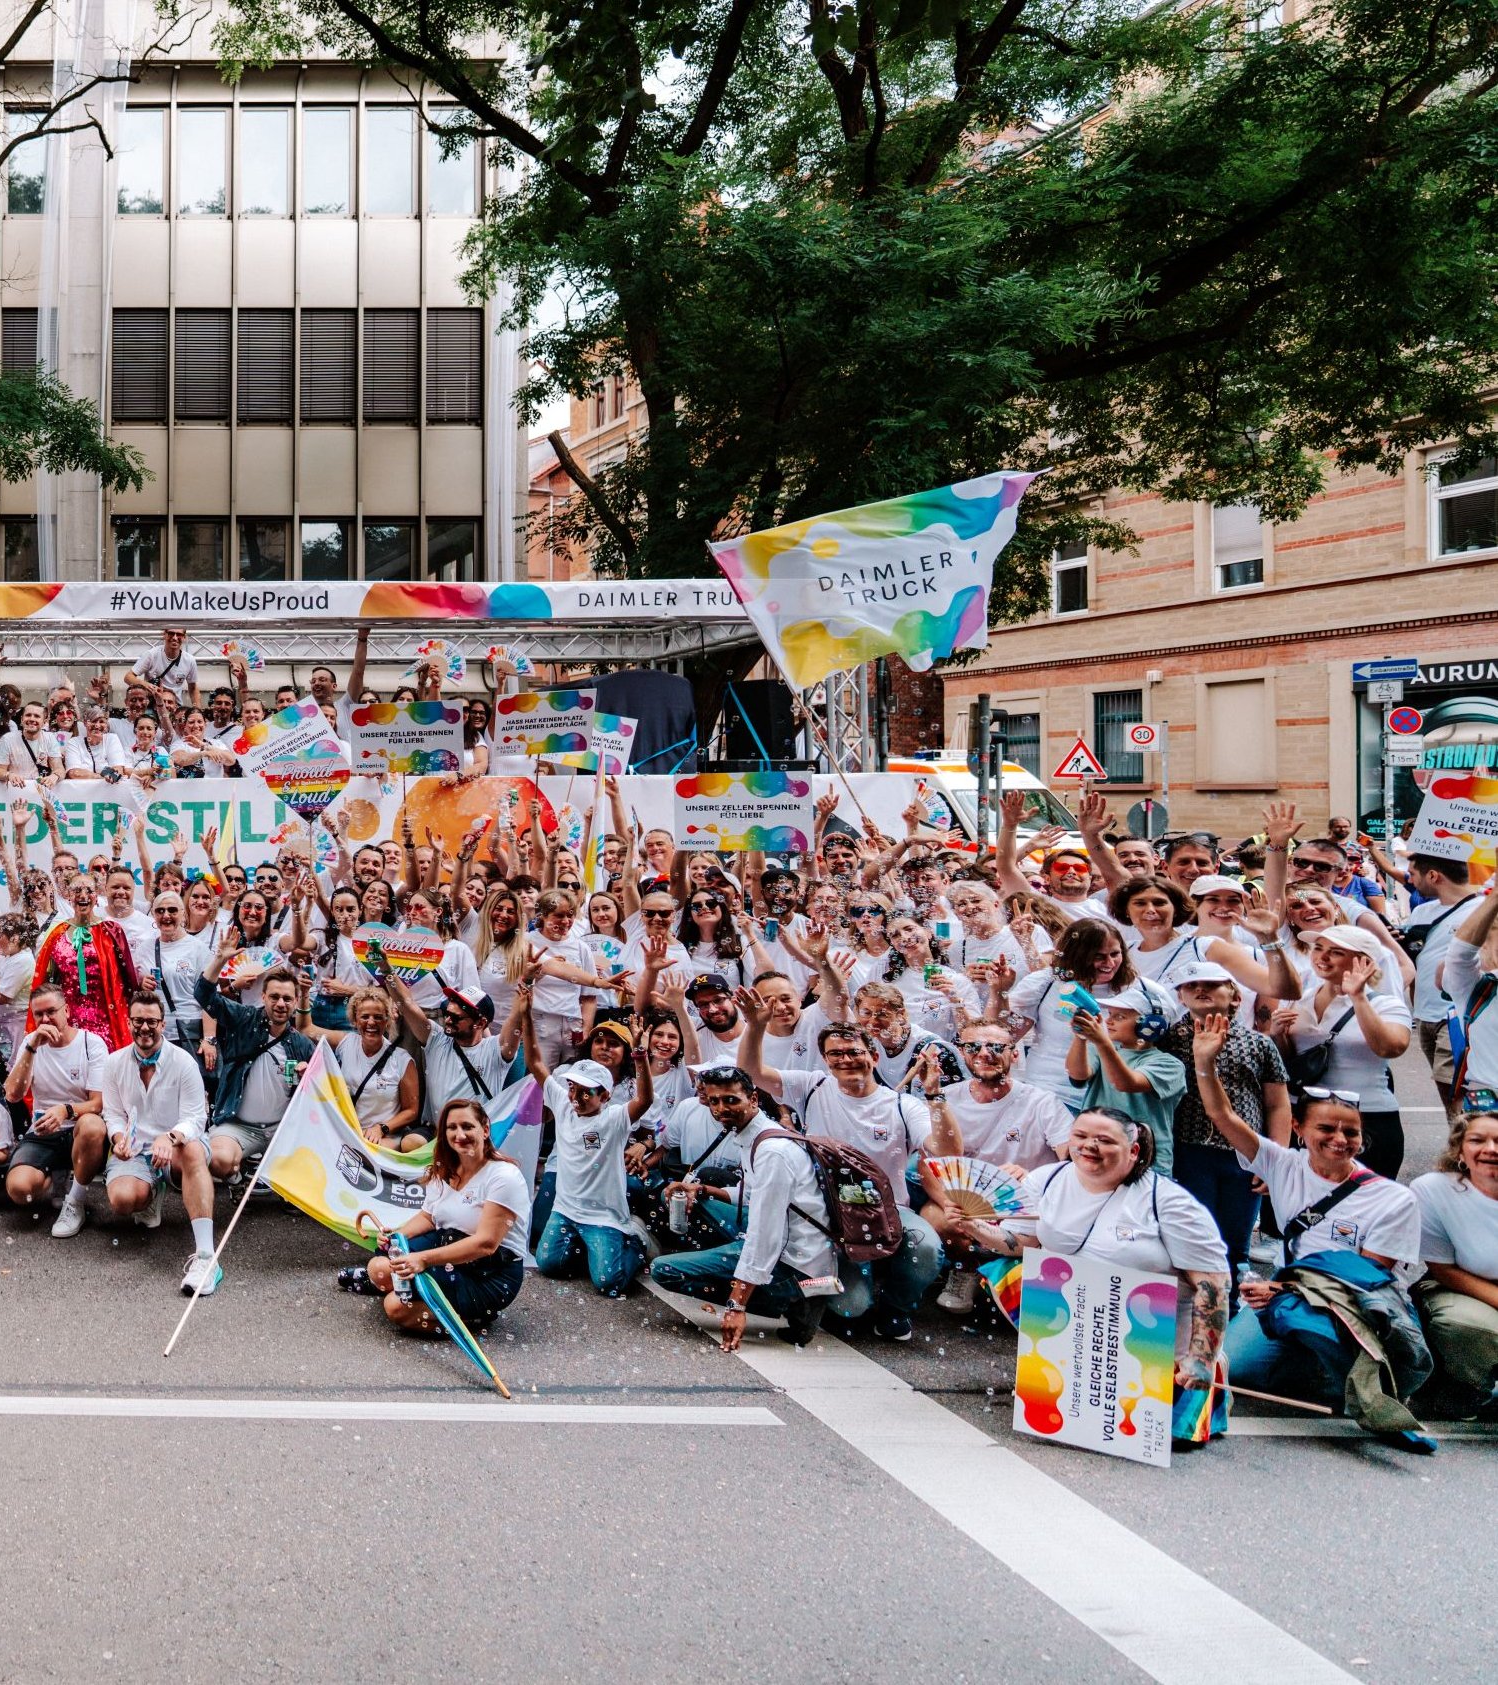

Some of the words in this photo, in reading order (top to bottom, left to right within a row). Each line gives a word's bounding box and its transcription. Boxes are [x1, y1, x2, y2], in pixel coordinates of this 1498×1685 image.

[819, 552, 953, 592] DAIMLER
[110, 591, 329, 611] #YouMakeUsProud
[578, 591, 677, 607] DAIMLER
[843, 576, 937, 606] TRUCK
[1135, 730, 1150, 740] 30
[282, 760, 334, 780] Proud
[290, 785, 332, 805] Loud
[1449, 803, 1487, 815] Unsere
[1428, 818, 1465, 831] VOLLE
[1414, 837, 1461, 851] DAIMLER
[1420, 845, 1451, 856] TRUCK
[695, 976, 708, 985] M
[390, 1195, 425, 1205] German
[1074, 1284, 1087, 1321] Fracht:
[1092, 1304, 1107, 1353] RECHTE,
[1105, 1275, 1122, 1401] SELBSTBESTIMMUNG
[1074, 1322, 1085, 1379] wertvollste
[1089, 1355, 1103, 1407] GLEICHE
[1069, 1380, 1082, 1418] Unsere
[1103, 1403, 1116, 1442] VOLLE
[1143, 1409, 1153, 1458] DAIMLER
[1155, 1419, 1165, 1453] TRUCK
